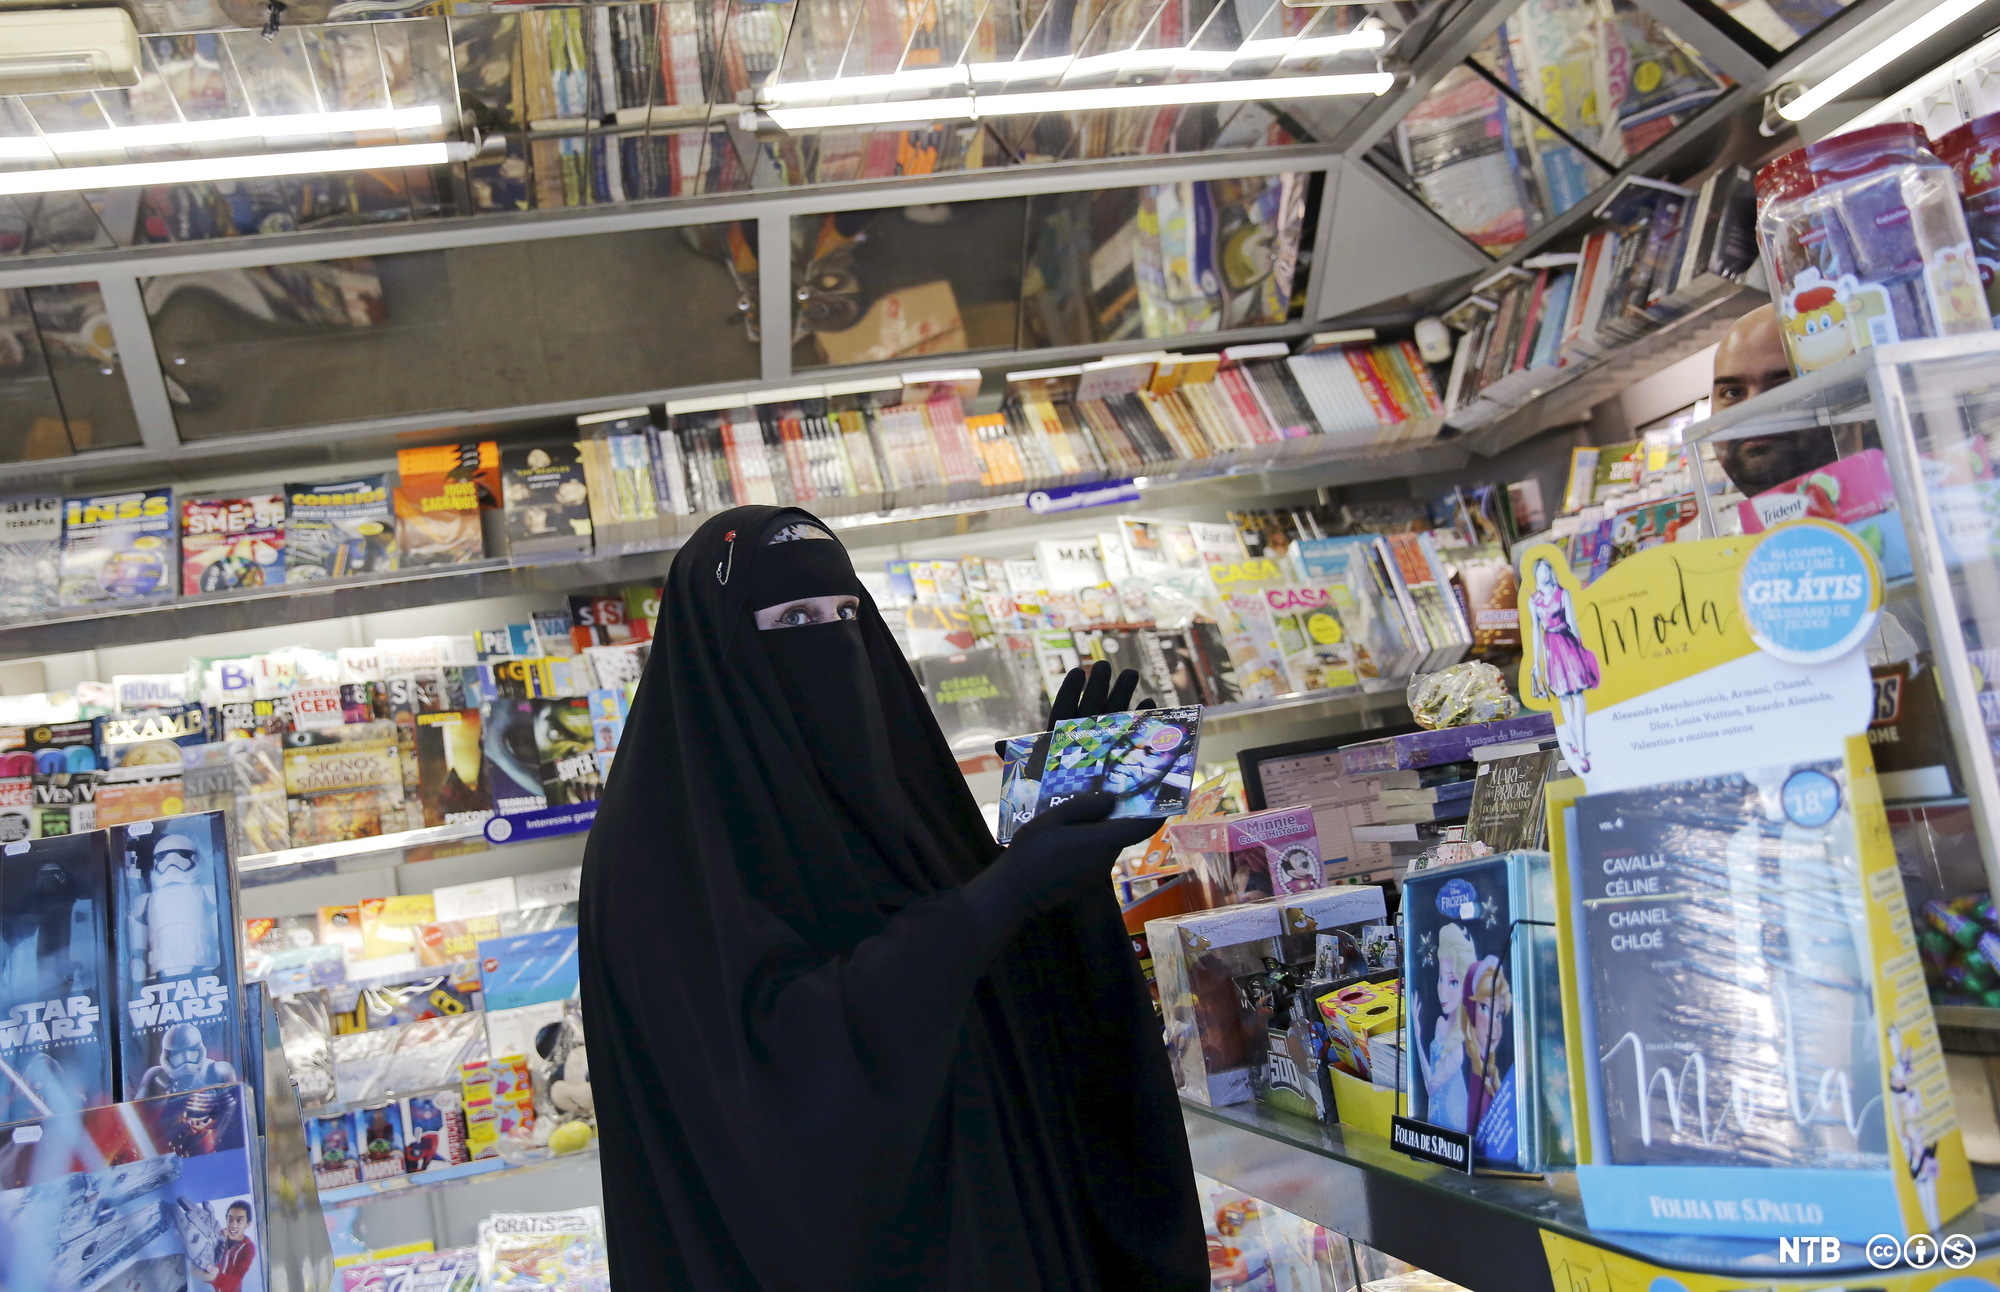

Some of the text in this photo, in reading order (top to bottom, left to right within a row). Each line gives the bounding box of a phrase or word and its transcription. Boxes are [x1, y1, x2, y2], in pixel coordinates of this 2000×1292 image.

[7, 498, 57, 513] arte
[291, 488, 387, 506] CORREIOS
[1762, 501, 1802, 521] Trident
[5, 517, 56, 529] TERAPIA
[1788, 547, 1834, 559] COMPRA
[1210, 559, 1281, 584] CASA
[1782, 556, 1835, 571] VOLUME
[1628, 590, 1649, 599] FOLHA
[1748, 570, 1862, 603] GRÁTIS
[1267, 588, 1332, 610] CASA
[906, 604, 971, 631] CAS
[1578, 556, 1737, 666] Moda
[1833, 605, 1851, 617] DE
[1665, 647, 1672, 655] A
[1682, 643, 1689, 652] Z
[1612, 676, 1814, 721] Alexandre Herchcovitch, Armani, Chanel,
[1649, 691, 1834, 732] Dior, Louis Vuitton, Ricardo Almeida,
[1465, 729, 1534, 747] Amigas do Reino
[1630, 725, 1754, 751] Valentino e muitos outros
[308, 756, 379, 774] SIGNOS
[1486, 766, 1519, 787] MARY
[1494, 781, 1532, 801] PRIORE
[526, 815, 573, 830] Interesses
[1245, 815, 1297, 835] Minnie
[1614, 817, 1624, 829] 4
[1239, 832, 1267, 845] Conta
[1603, 854, 1665, 874] CAVALLI
[1606, 877, 1659, 897] CÉLINE
[1311, 905, 1329, 916] Livro
[1441, 893, 1469, 910] FROZEN
[1609, 908, 1671, 928] CHANEL
[1198, 923, 1219, 935] Livro
[1611, 930, 1664, 950] CHLOÉ
[128, 975, 228, 1010] STAR
[0, 996, 99, 1028] STAR
[129, 993, 228, 1028] WARS
[0, 1012, 99, 1049] WARS
[184, 1016, 228, 1028] AWAKENS
[19, 1044, 49, 1055] FORCE
[54, 1036, 98, 1048] AWAKENS
[1395, 1124, 1464, 1162] FOLHA DE S.PAULO
[317, 1168, 359, 1190] MARVEL
[363, 1158, 405, 1180] MARVEL
[1649, 1196, 1824, 1225] FOLHA DE S.PAULO
[494, 1216, 557, 1235] GRATIS
